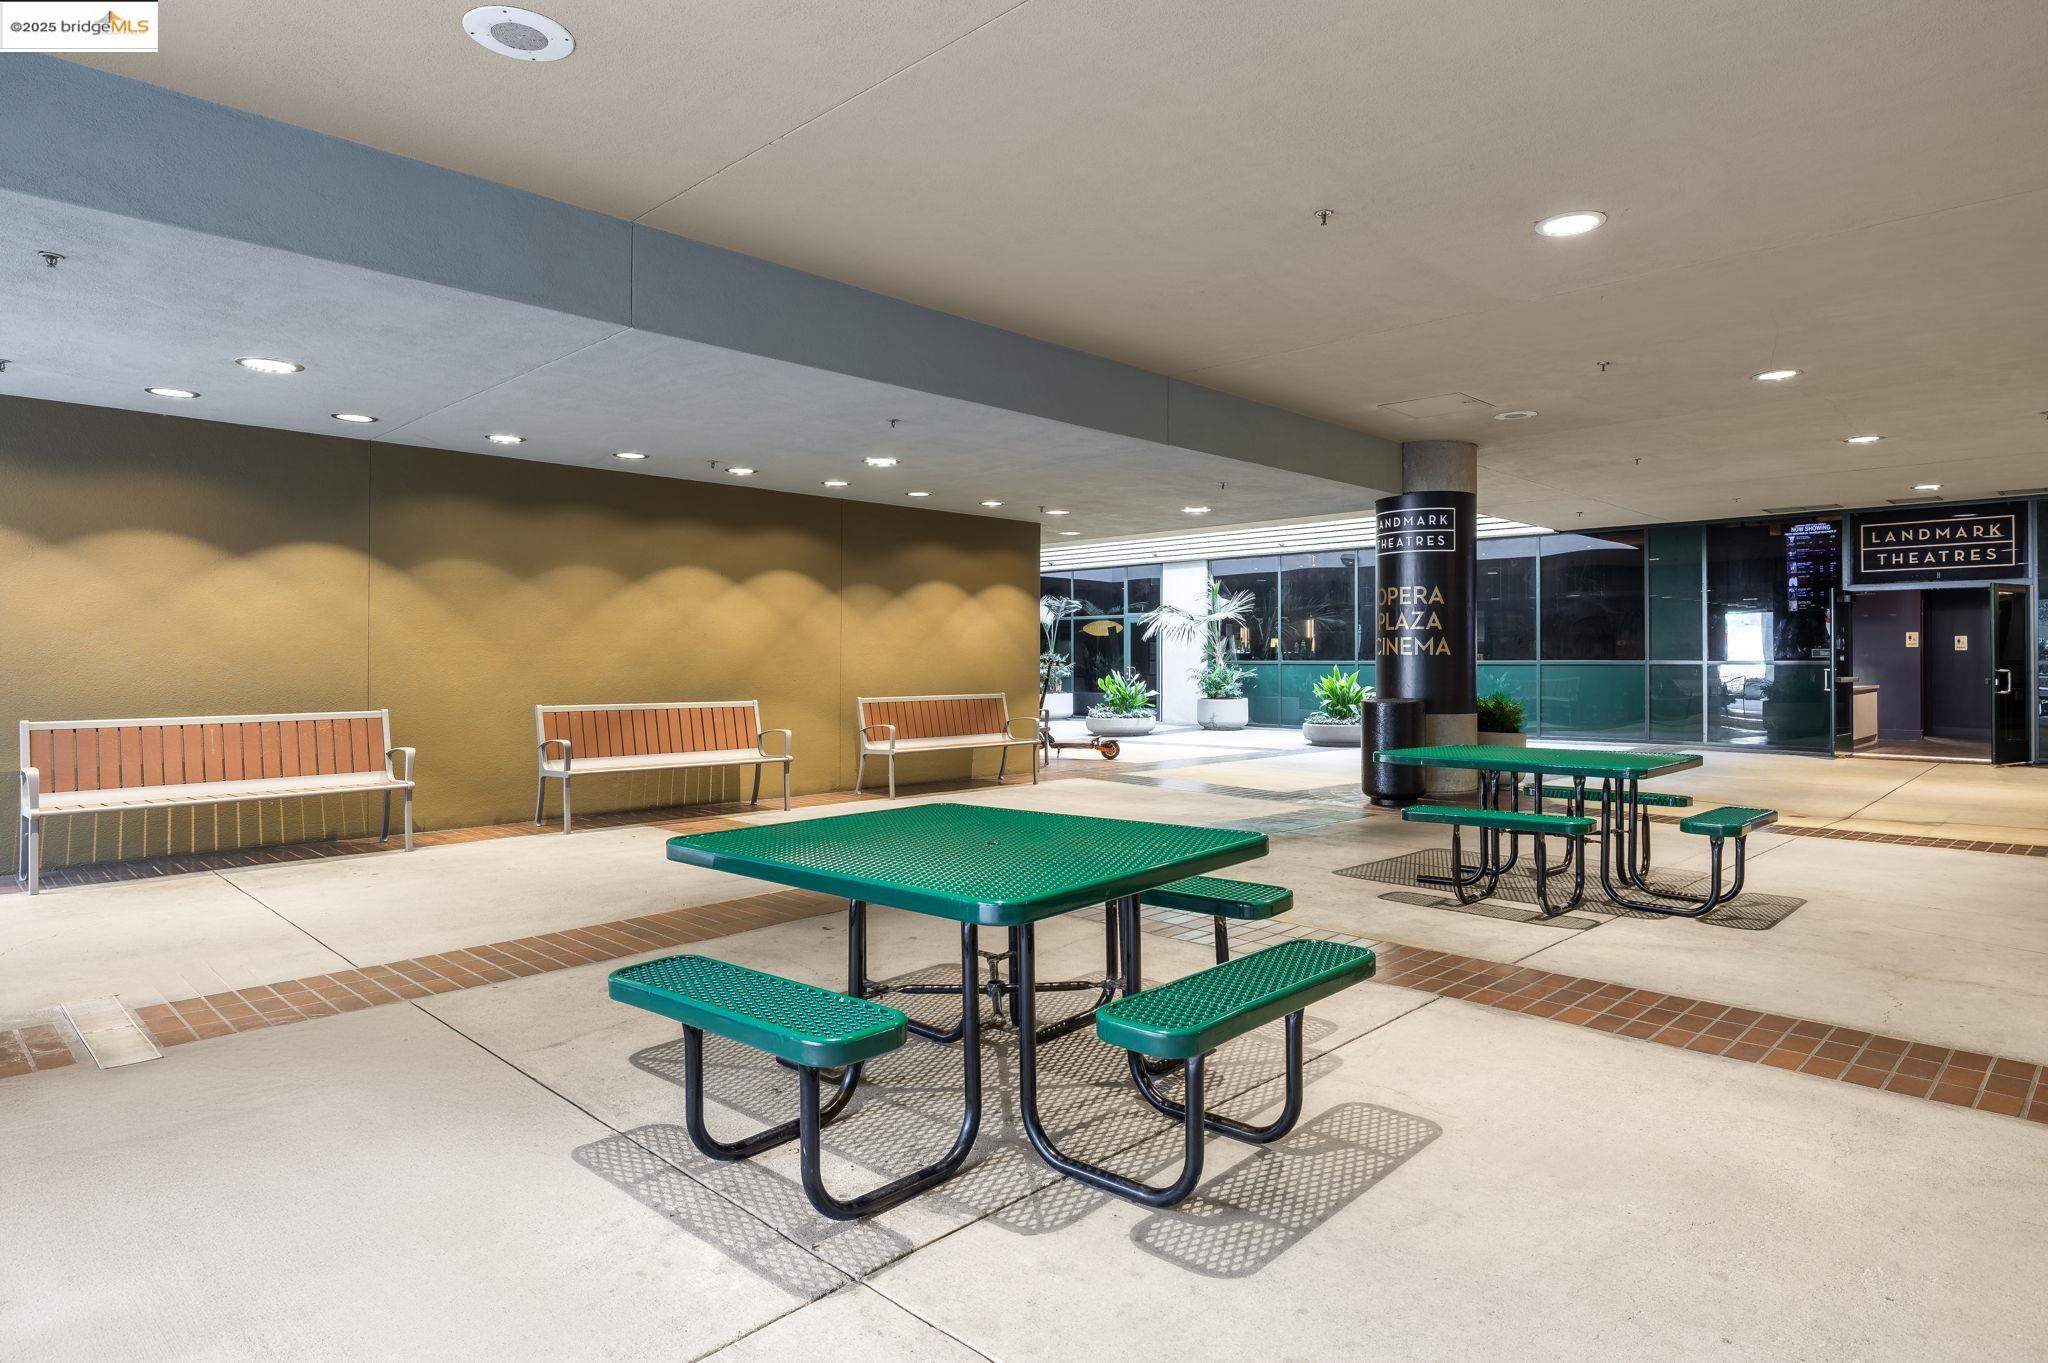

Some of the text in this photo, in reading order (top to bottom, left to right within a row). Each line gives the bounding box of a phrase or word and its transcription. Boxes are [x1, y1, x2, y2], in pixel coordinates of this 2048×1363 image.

[1377, 514, 1448, 530] ANDMARK
[1805, 524, 1831, 532] SHOWING
[1872, 524, 2001, 543] LANDMARK
[1877, 548, 1997, 565] THEATRES
[1378, 585, 1445, 606] OPERA
[1378, 611, 1442, 631] PLAZA
